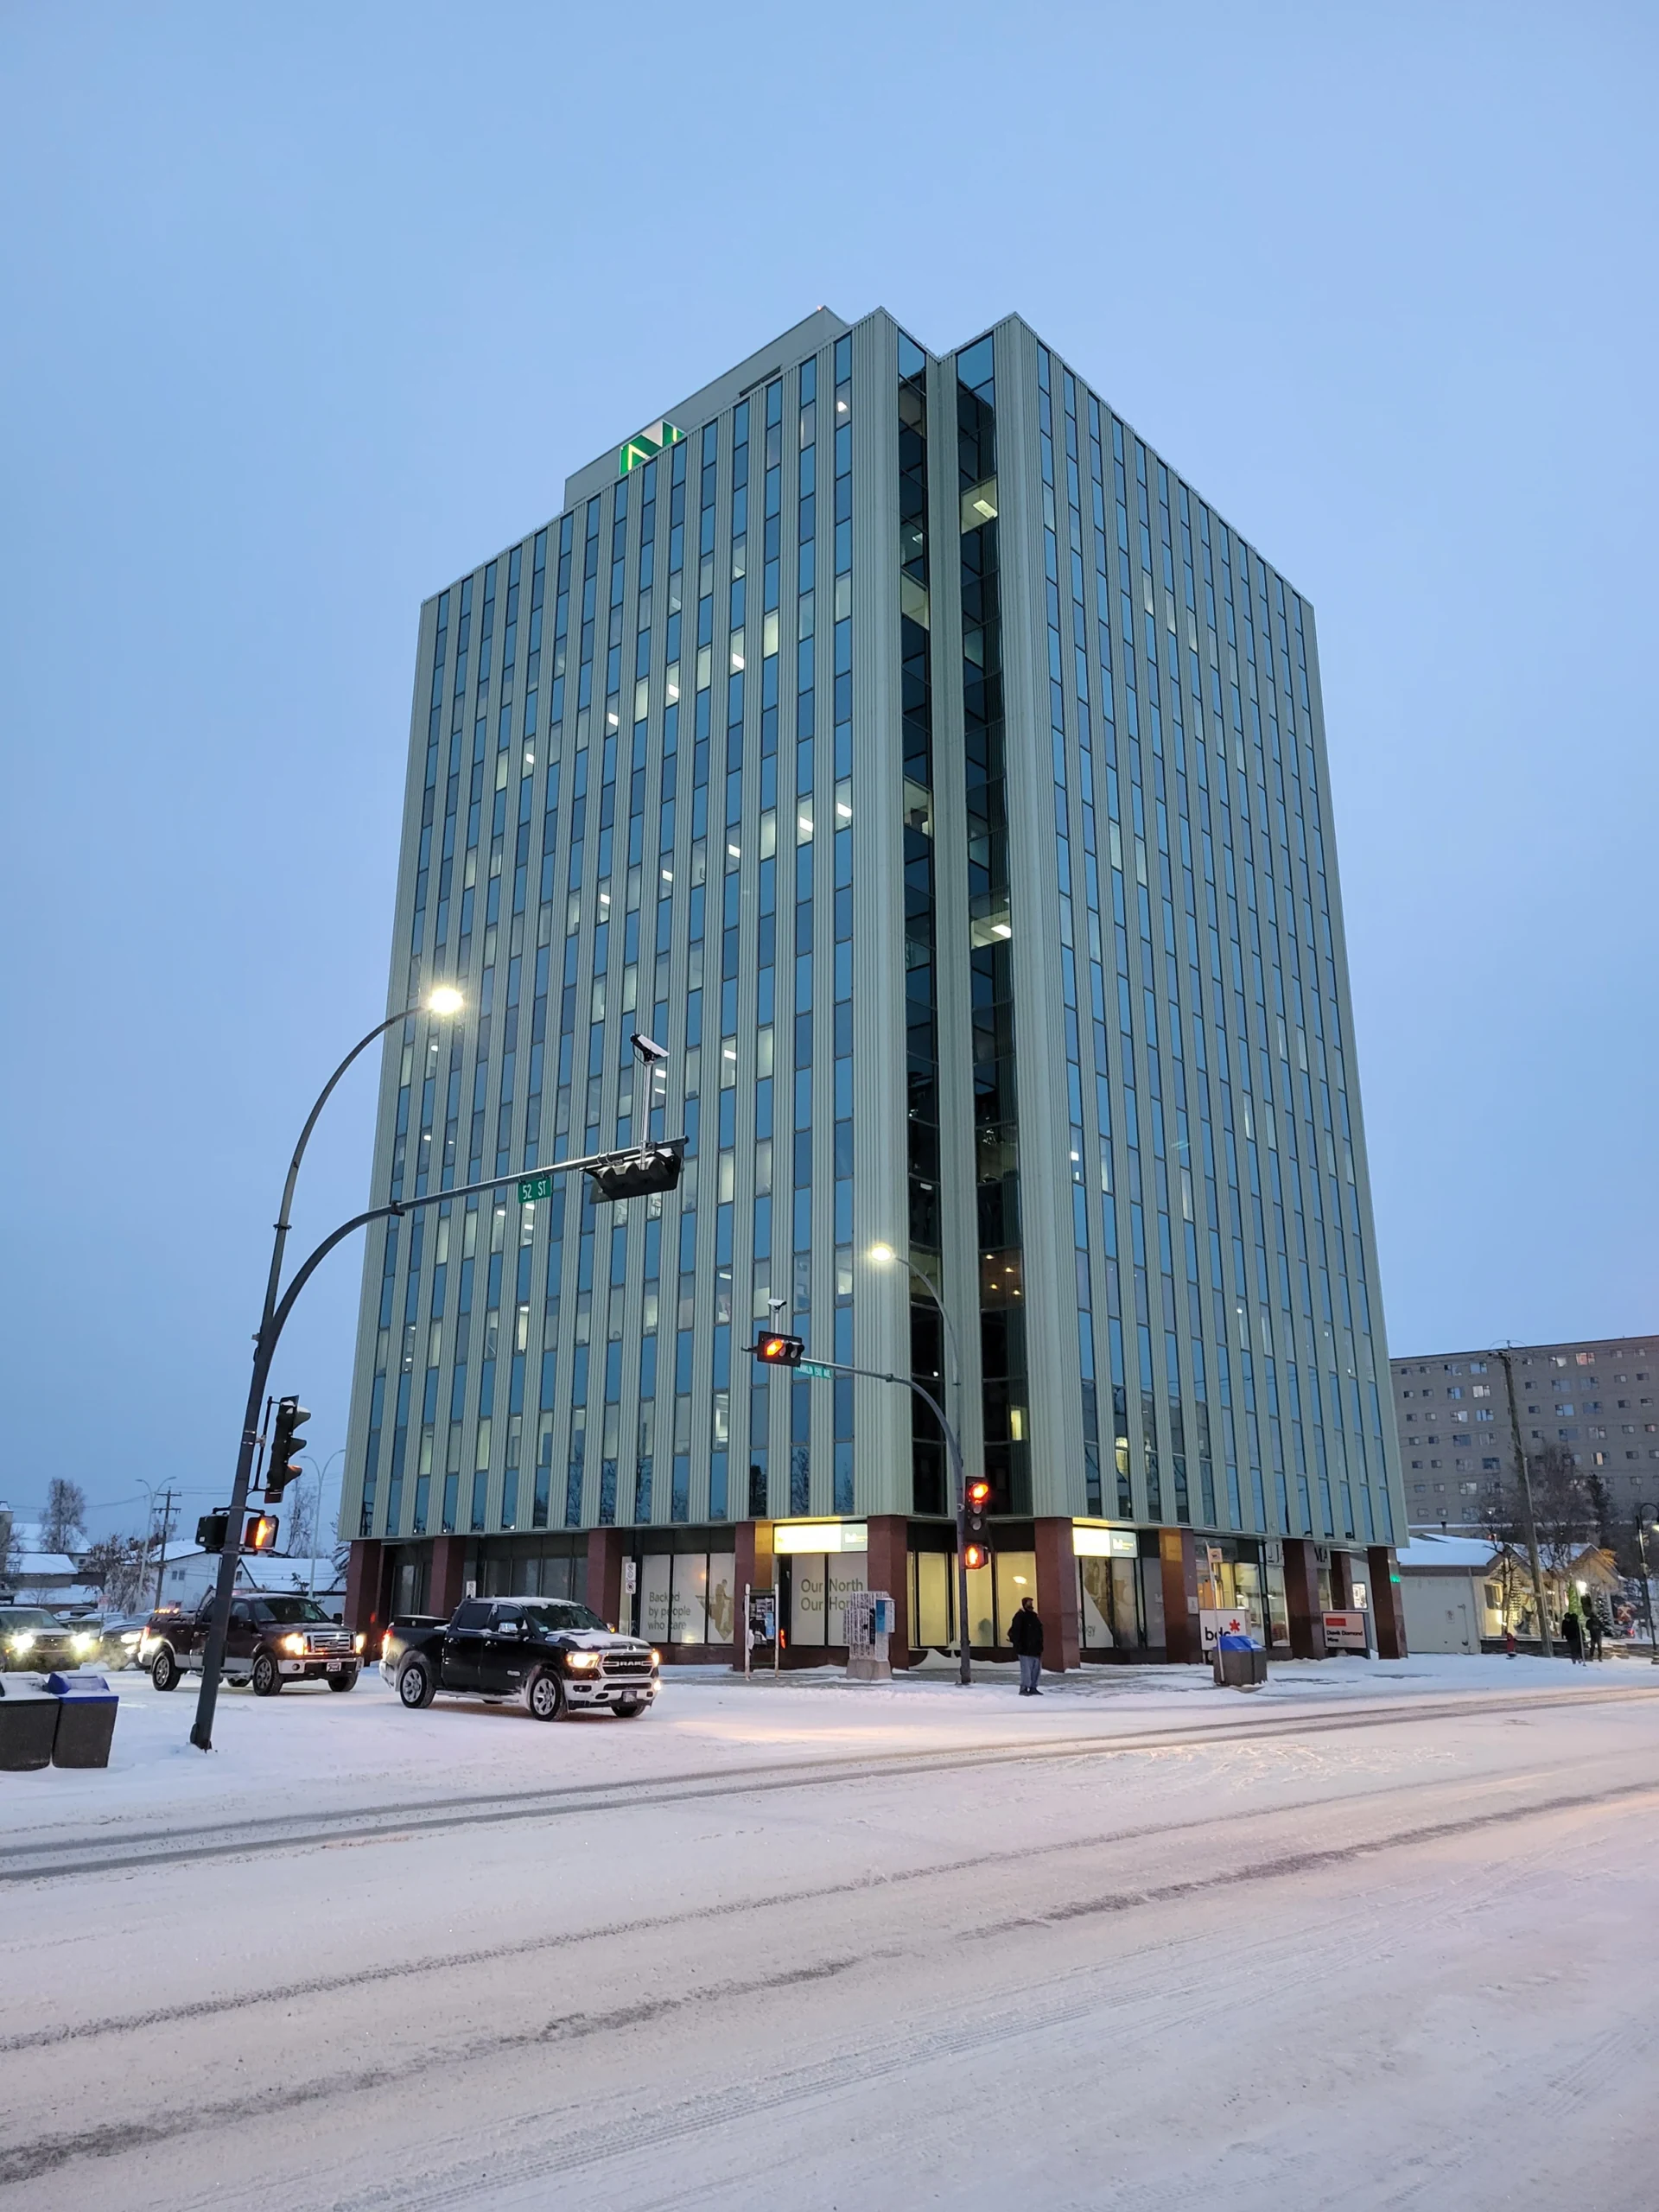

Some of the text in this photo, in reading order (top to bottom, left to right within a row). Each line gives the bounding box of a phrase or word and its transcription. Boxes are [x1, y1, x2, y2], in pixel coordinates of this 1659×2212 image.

[523, 1180, 546, 1200] 52 ST
[801, 1578, 863, 1592] Our North
[649, 1591, 680, 1602] Backd
[801, 1596, 852, 1611] Our Ho
[648, 1605, 659, 1618] by
[647, 1620, 687, 1630] who are
